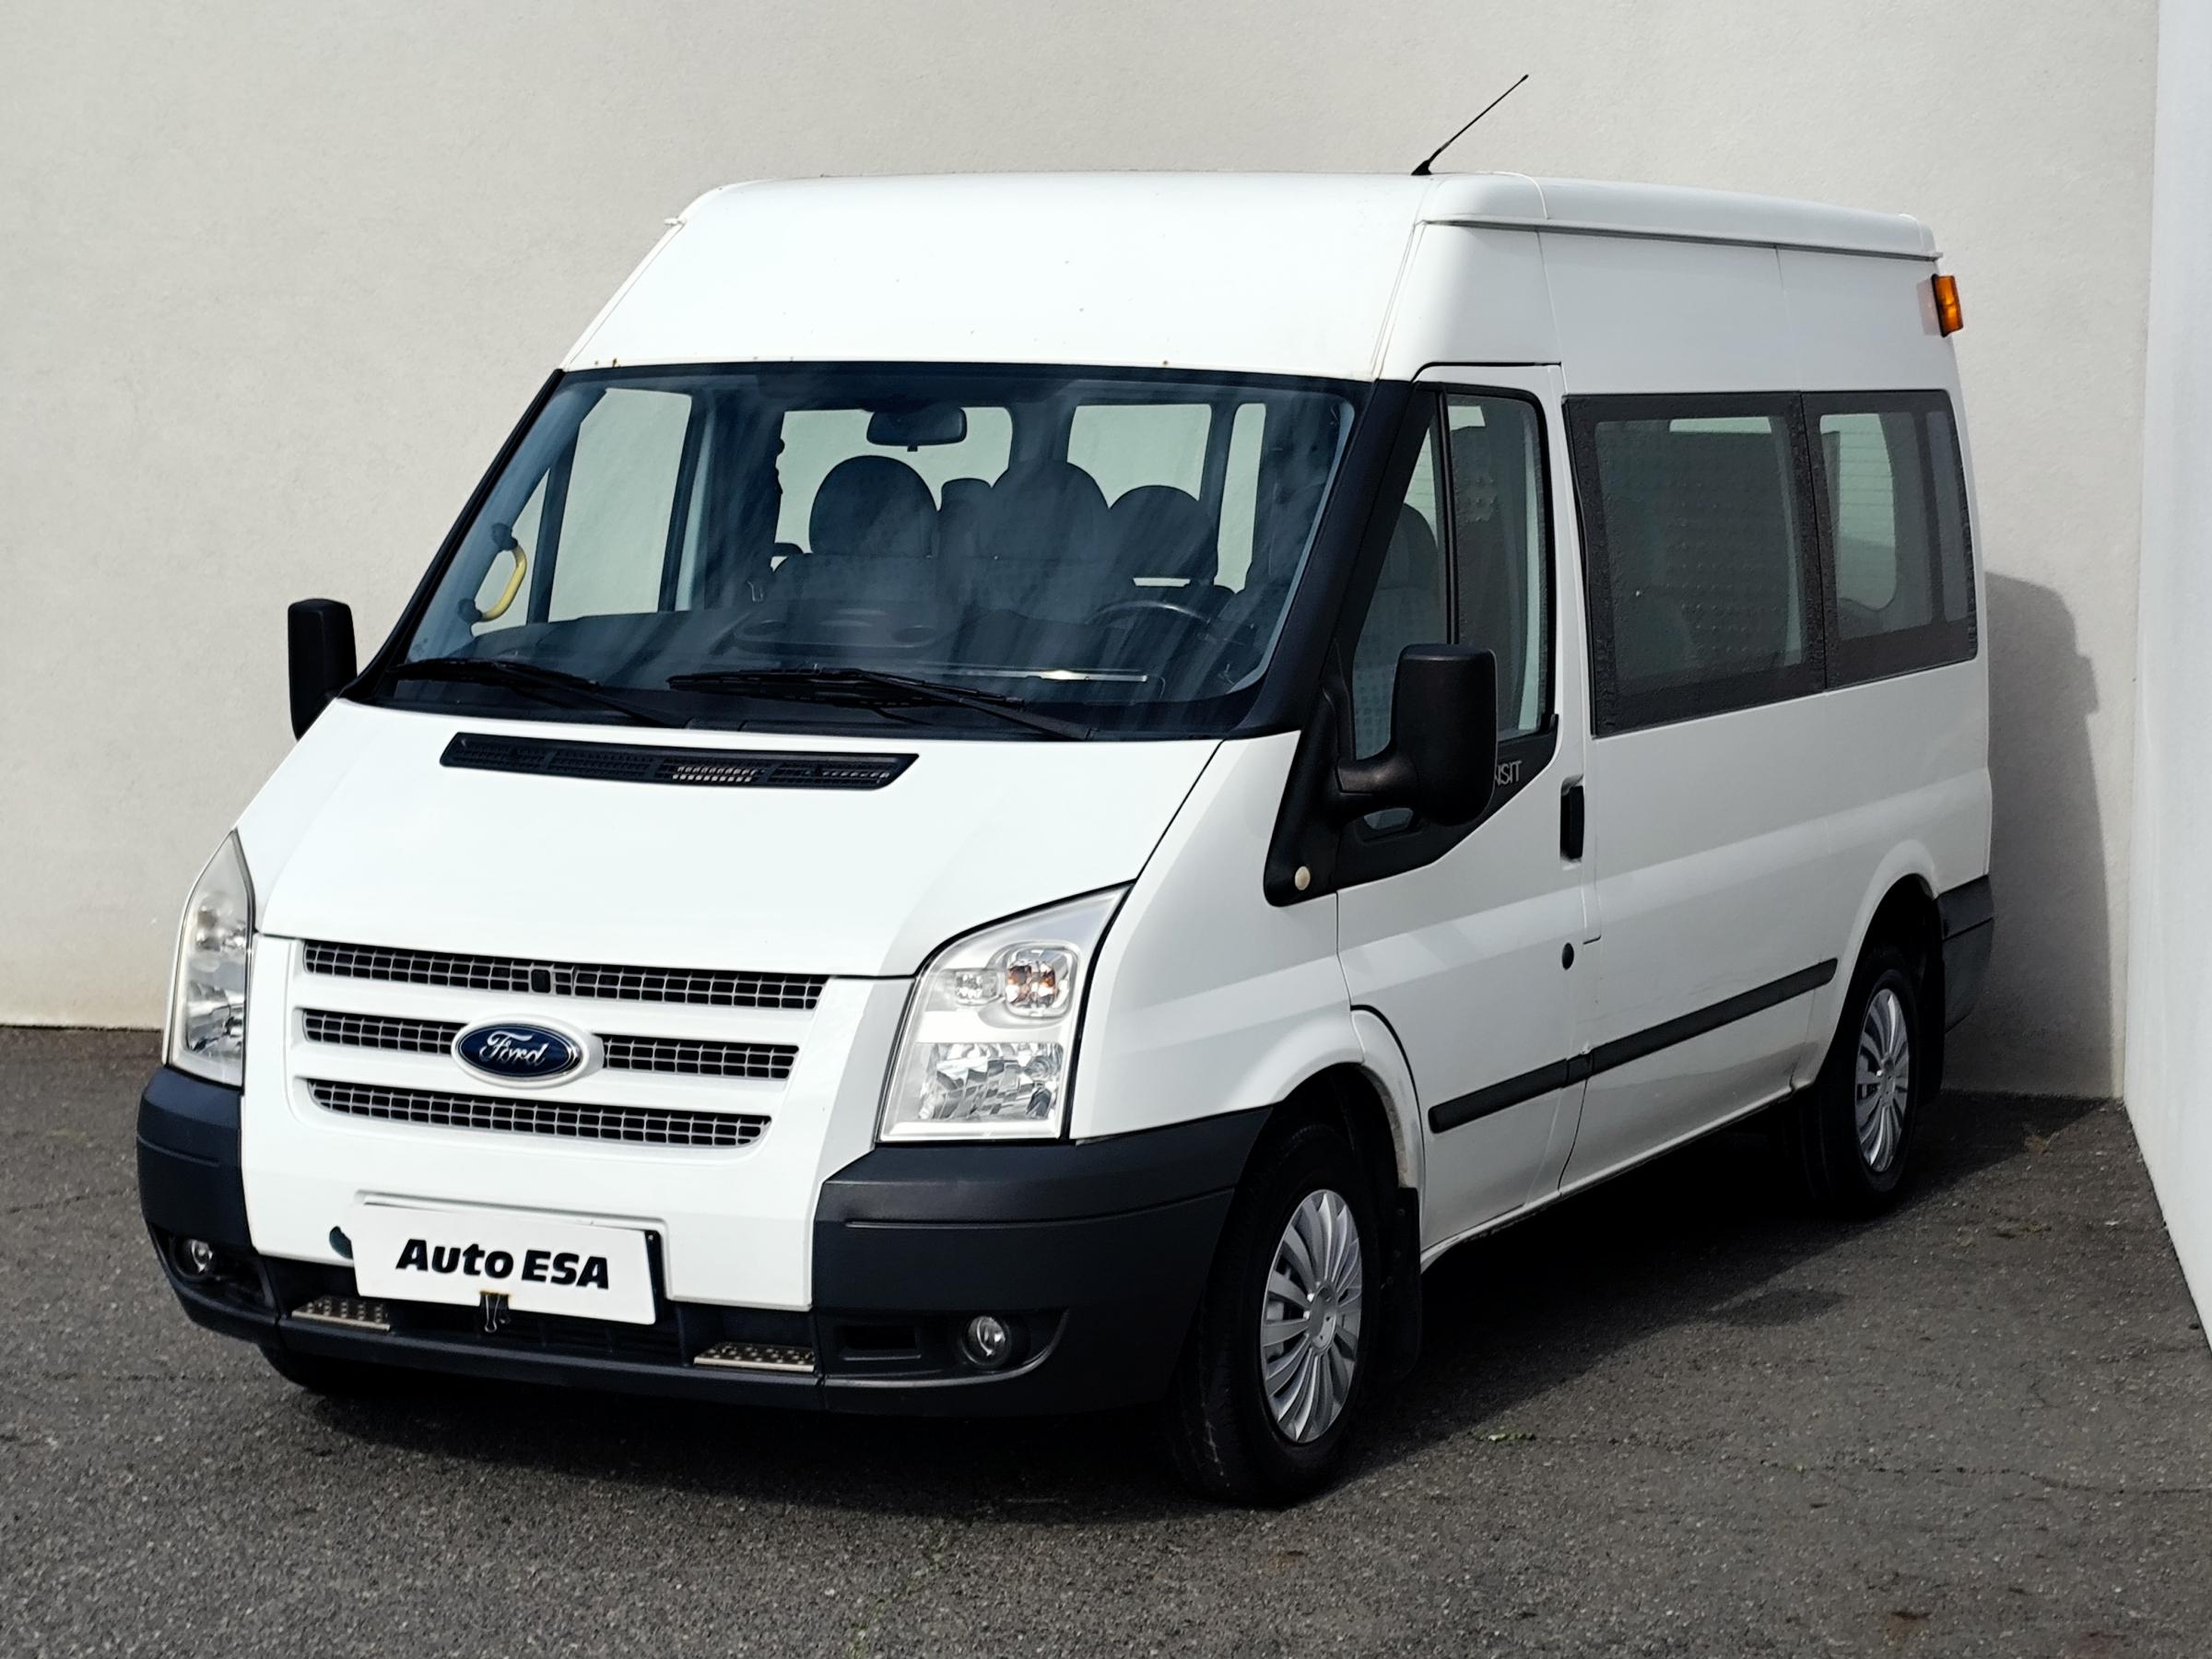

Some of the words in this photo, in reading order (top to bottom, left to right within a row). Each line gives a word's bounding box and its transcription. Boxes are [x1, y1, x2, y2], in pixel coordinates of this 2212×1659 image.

[478, 1030, 549, 1066] Ford
[395, 1239, 513, 1279] Auto
[521, 1249, 609, 1289] ESA
